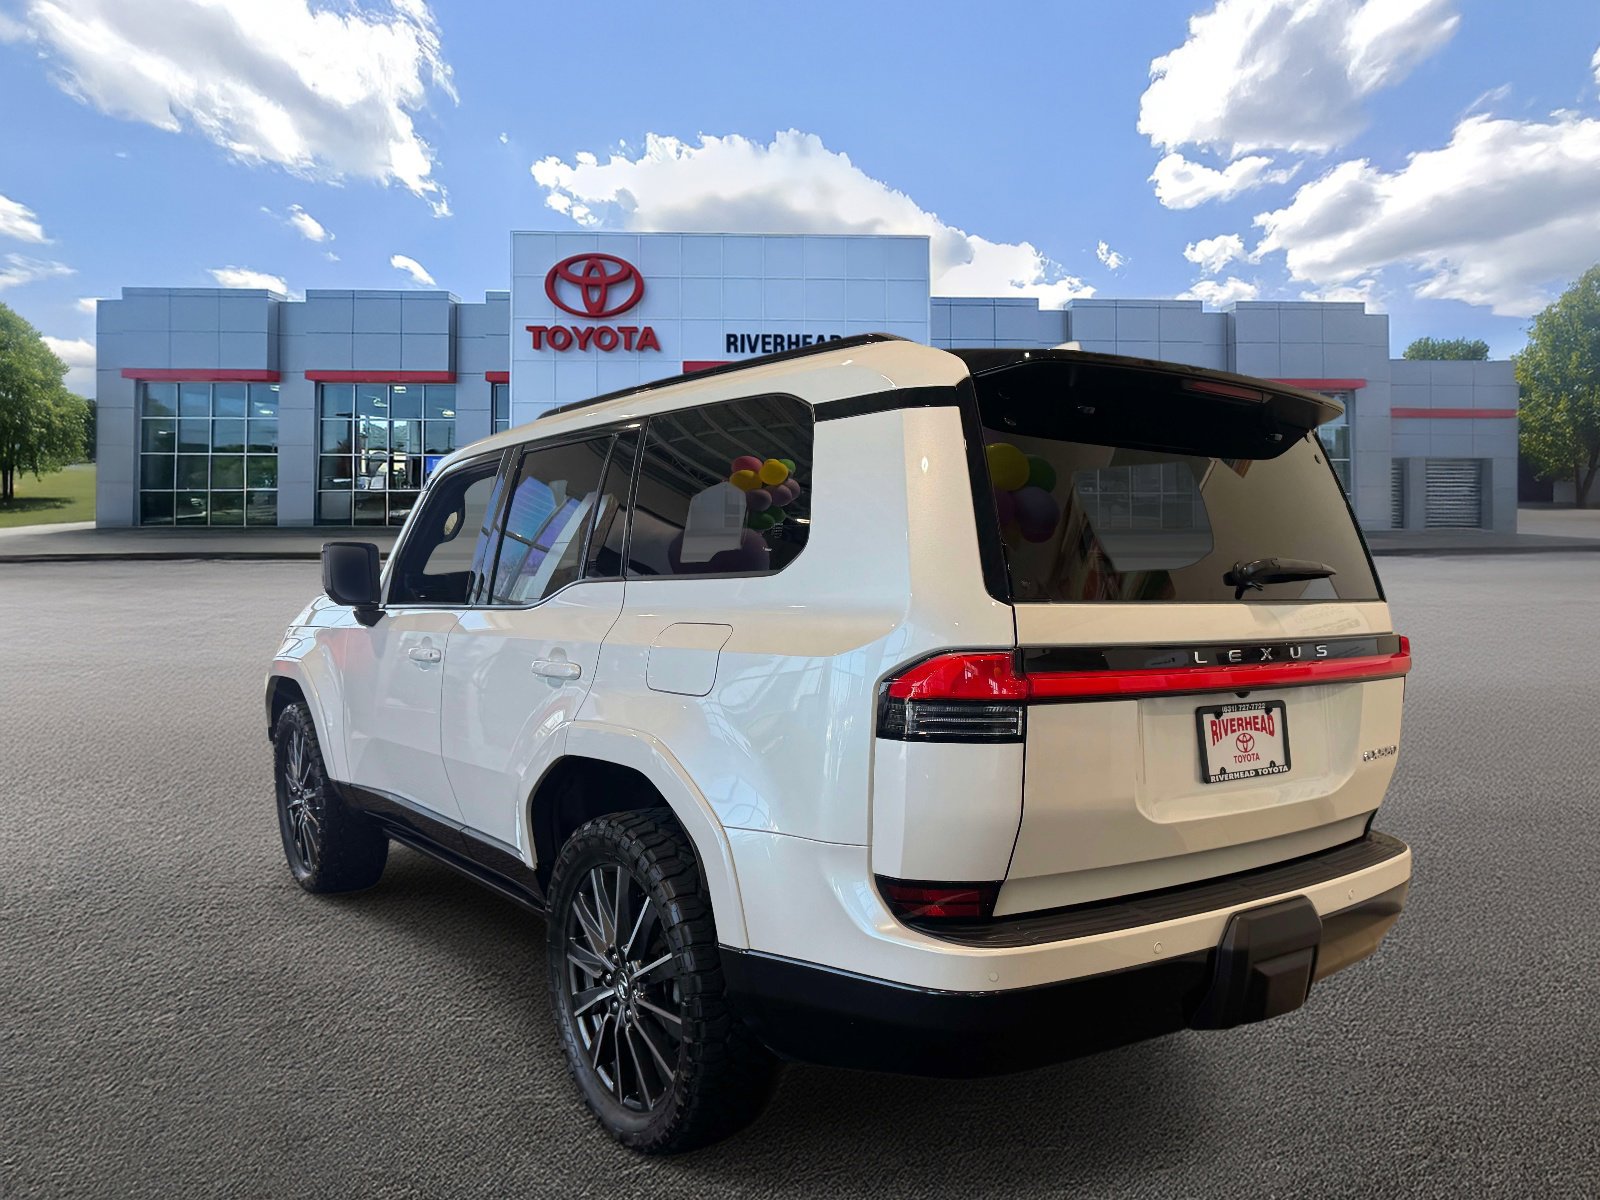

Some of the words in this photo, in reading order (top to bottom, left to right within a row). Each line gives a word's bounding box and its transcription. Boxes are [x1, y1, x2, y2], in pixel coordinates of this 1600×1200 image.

[526, 325, 661, 352] TOYOTA
[726, 333, 842, 353] RIVERHE
[1194, 644, 1328, 664] LEXUS
[1210, 714, 1275, 747] RIVERHEAD
[1233, 753, 1260, 763] TOYOTA
[1210, 770, 1256, 783] RIVERHEAD
[1257, 765, 1289, 777] TOYOTA
